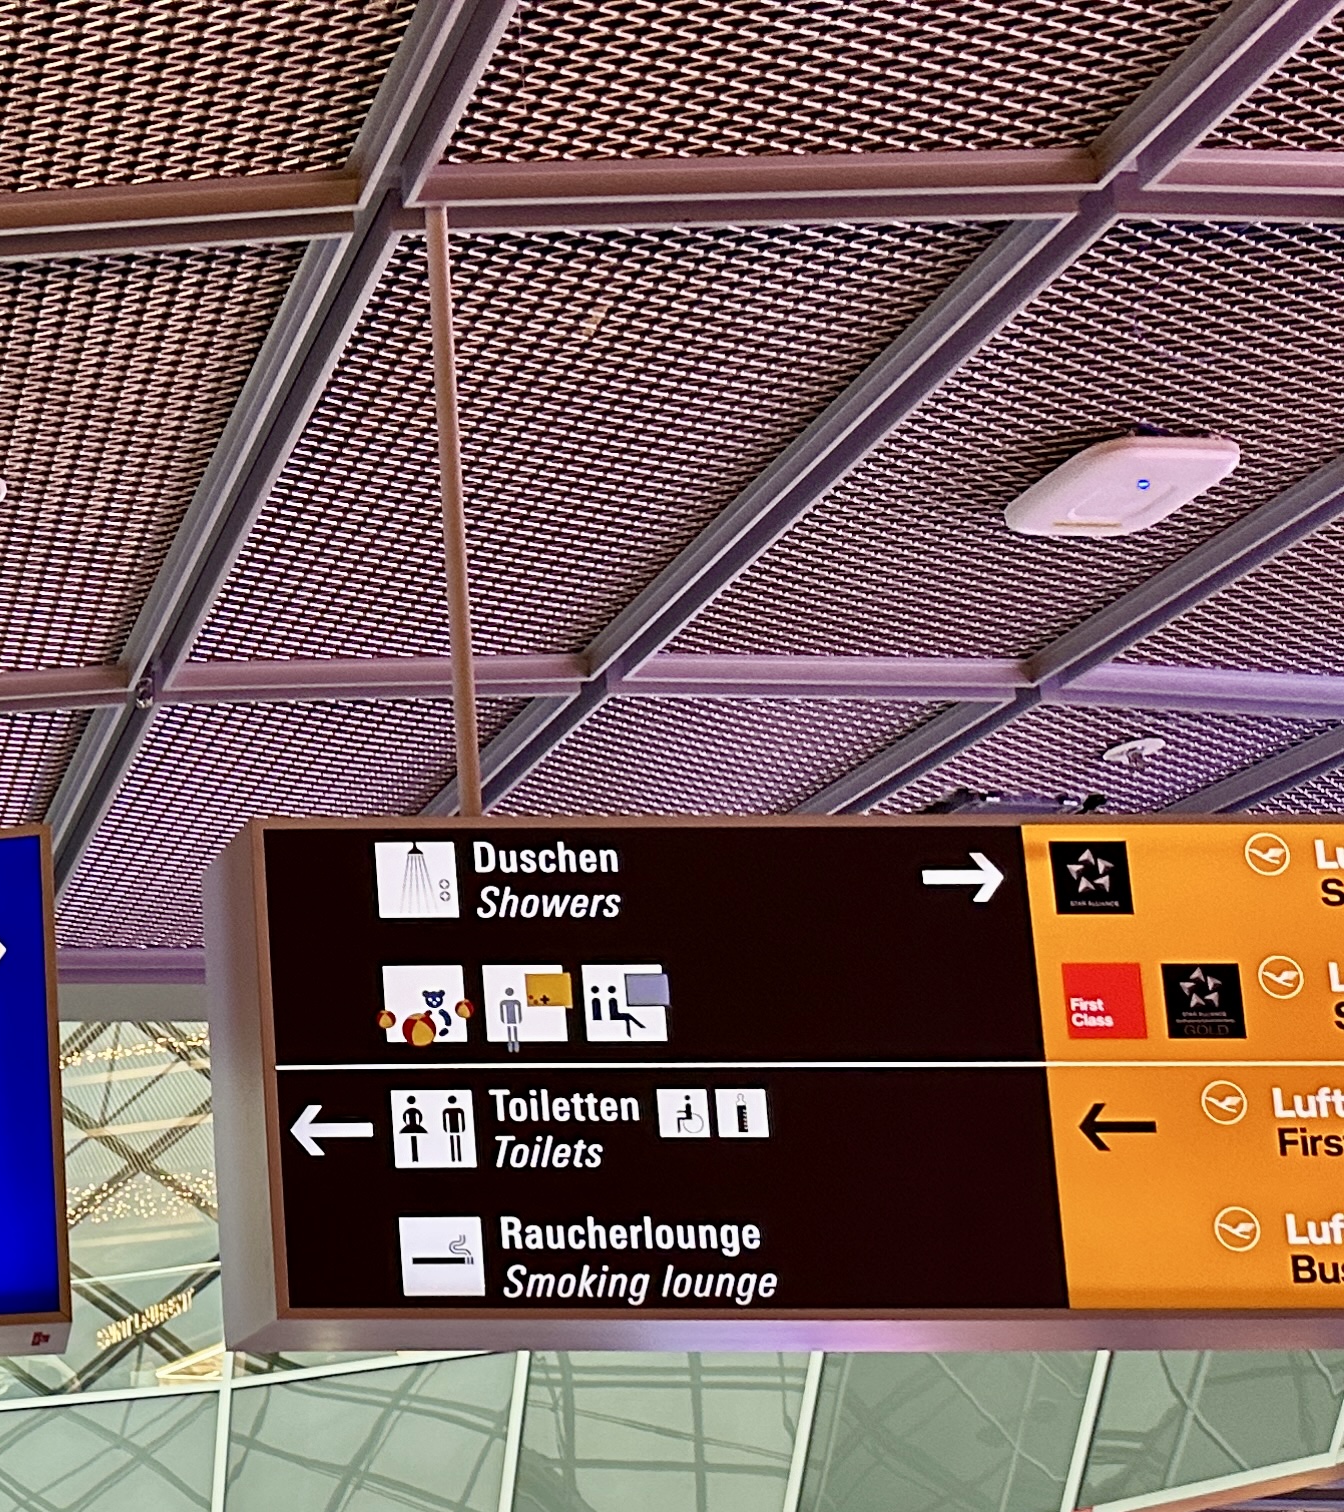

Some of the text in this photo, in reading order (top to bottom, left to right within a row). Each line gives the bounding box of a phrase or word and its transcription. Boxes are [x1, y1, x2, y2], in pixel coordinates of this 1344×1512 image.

[472, 841, 620, 874] Duschen
[476, 886, 622, 919] Showers
[1069, 997, 1105, 1012] First
[1071, 1012, 1114, 1028] Class
[1183, 1024, 1230, 1036] GOLD
[487, 1088, 641, 1123] Toiletten
[494, 1135, 604, 1169] Toilets
[499, 1216, 761, 1257] Raucherlounge
[502, 1264, 779, 1306] Smoking lounge
[1291, 1254, 1344, 1284] Bu
